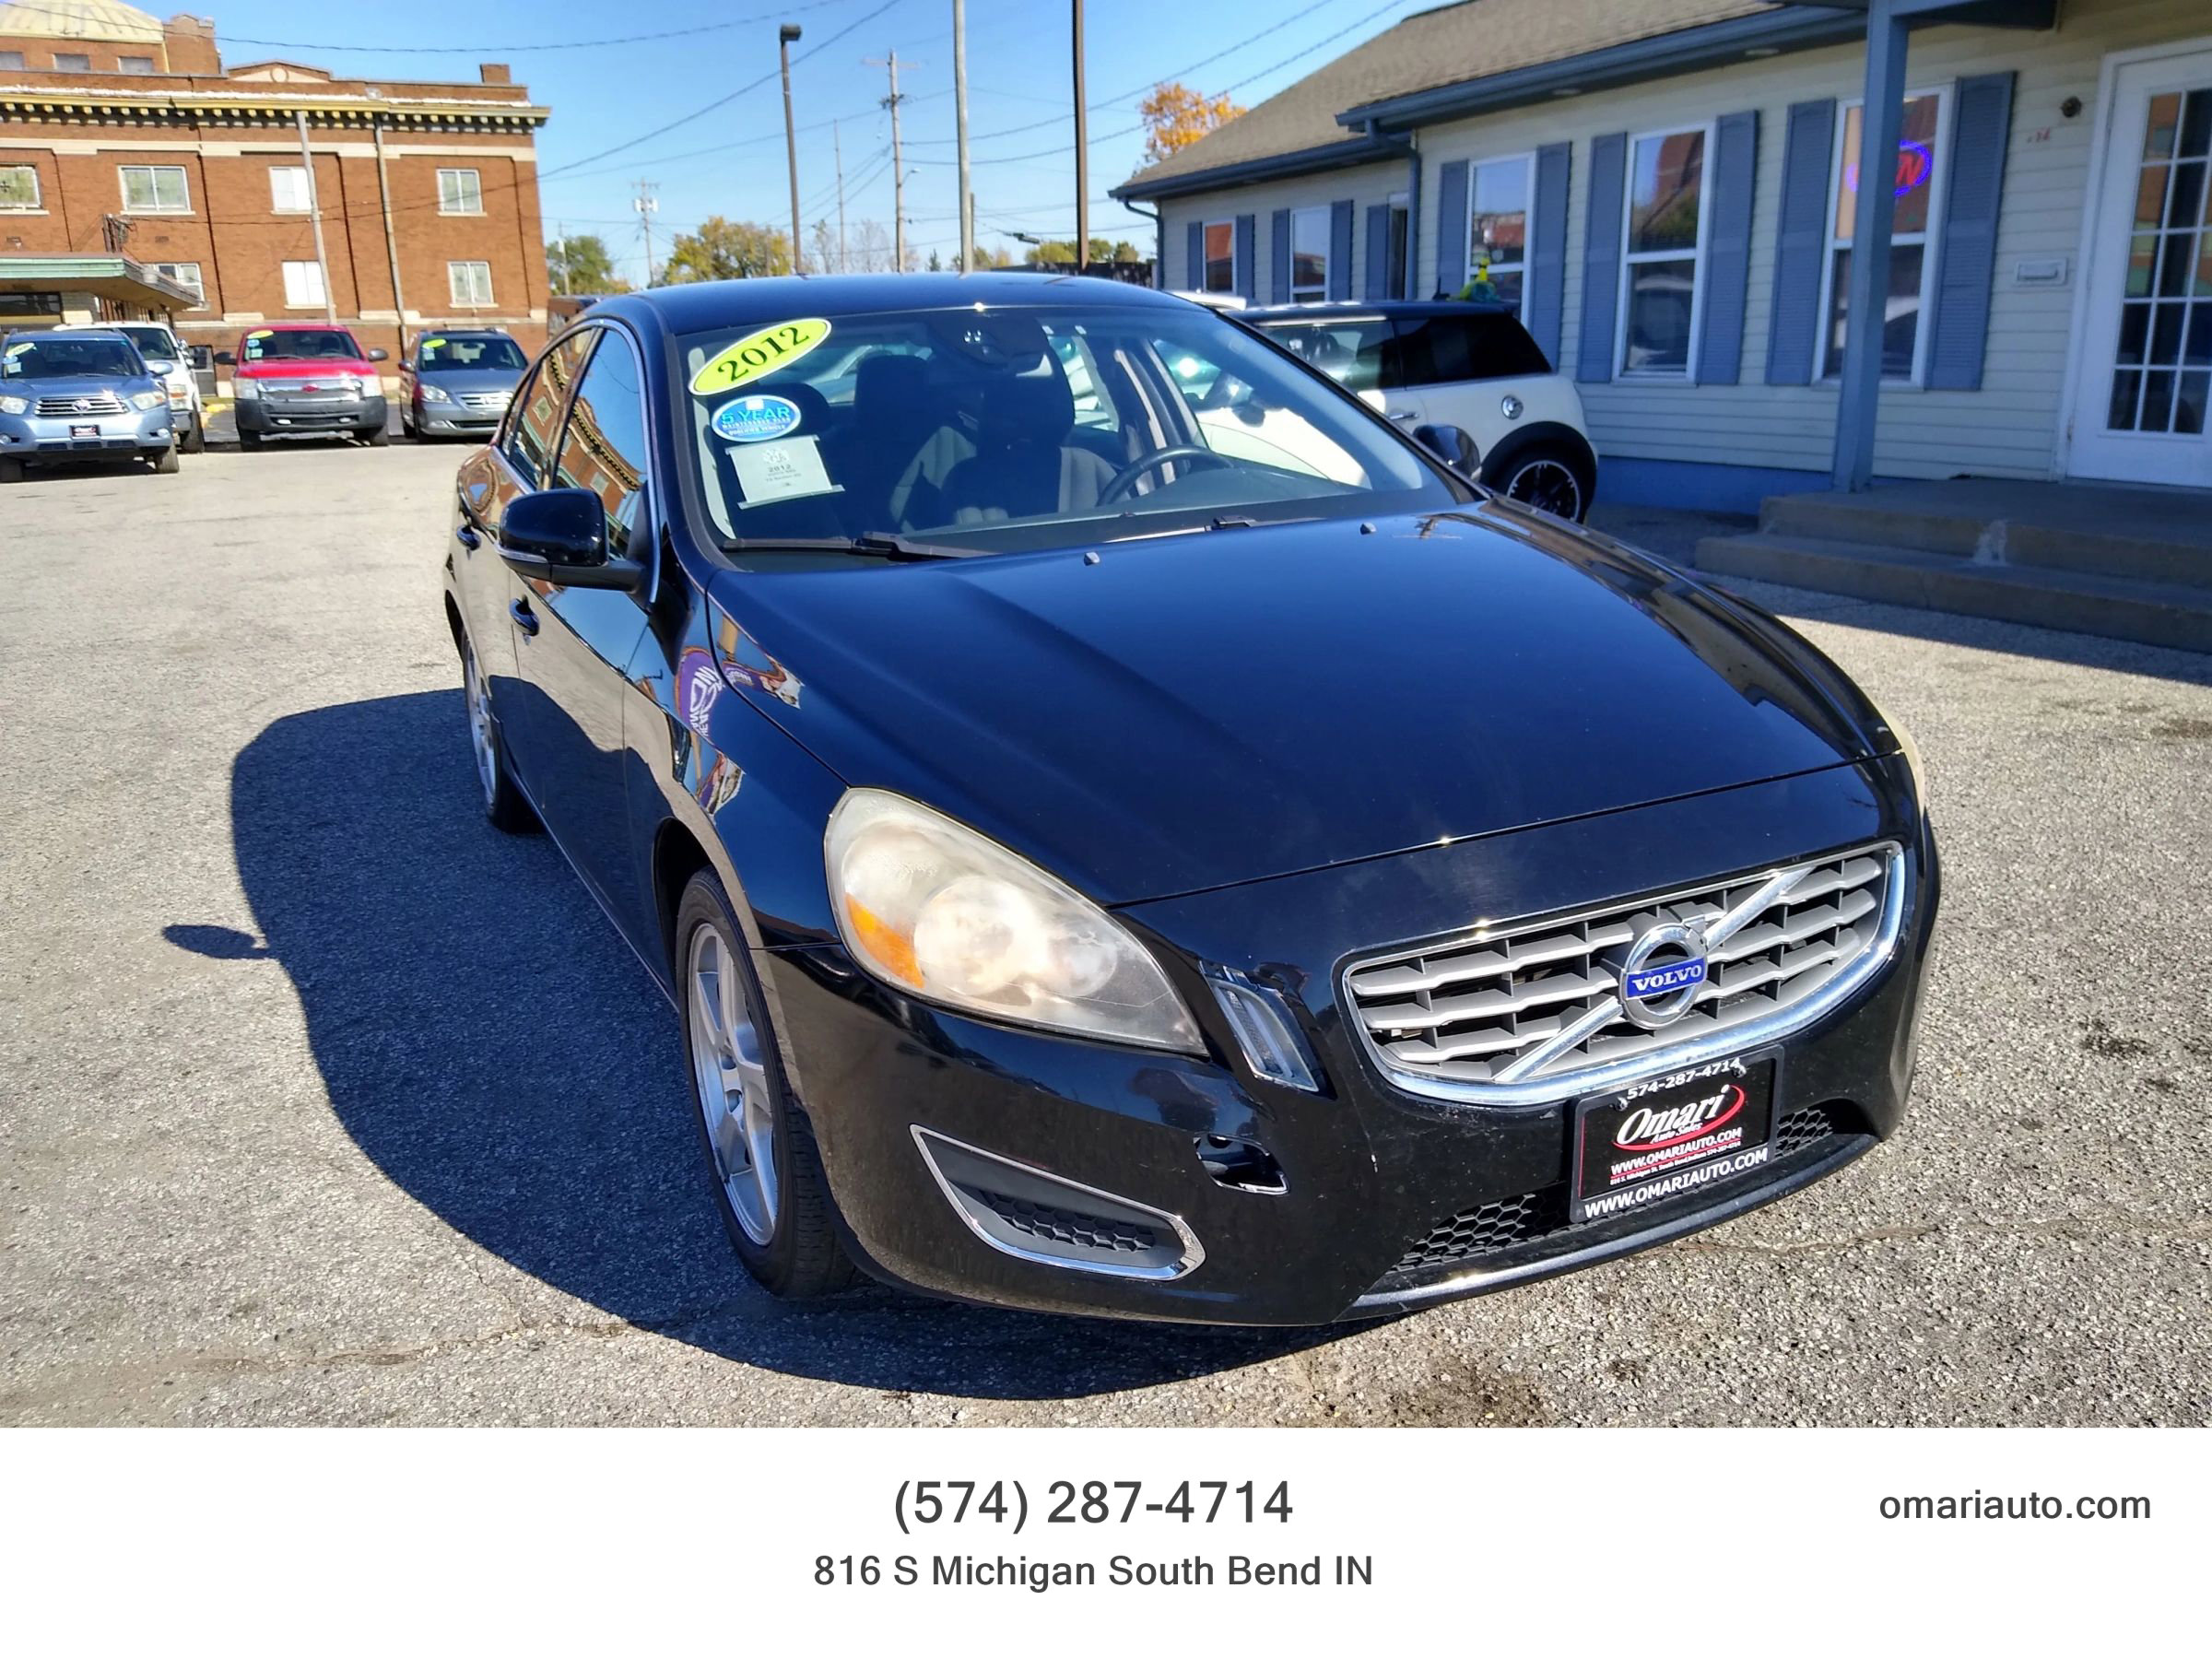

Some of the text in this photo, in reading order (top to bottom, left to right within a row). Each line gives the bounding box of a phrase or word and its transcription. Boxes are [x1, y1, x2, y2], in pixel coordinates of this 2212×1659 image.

[718, 327, 809, 382] 2012
[723, 413, 735, 424] 5
[738, 407, 790, 421] YEAR
[1632, 965, 1702, 991] VOLVO
[1627, 1057, 1741, 1100] 574-287-4714
[1617, 1084, 1730, 1145] Omari
[1611, 1127, 1743, 1175] WWW.OMARIAUTO.COM
[1584, 1148, 1768, 1218] WWW.OMARIAUTO.COM
